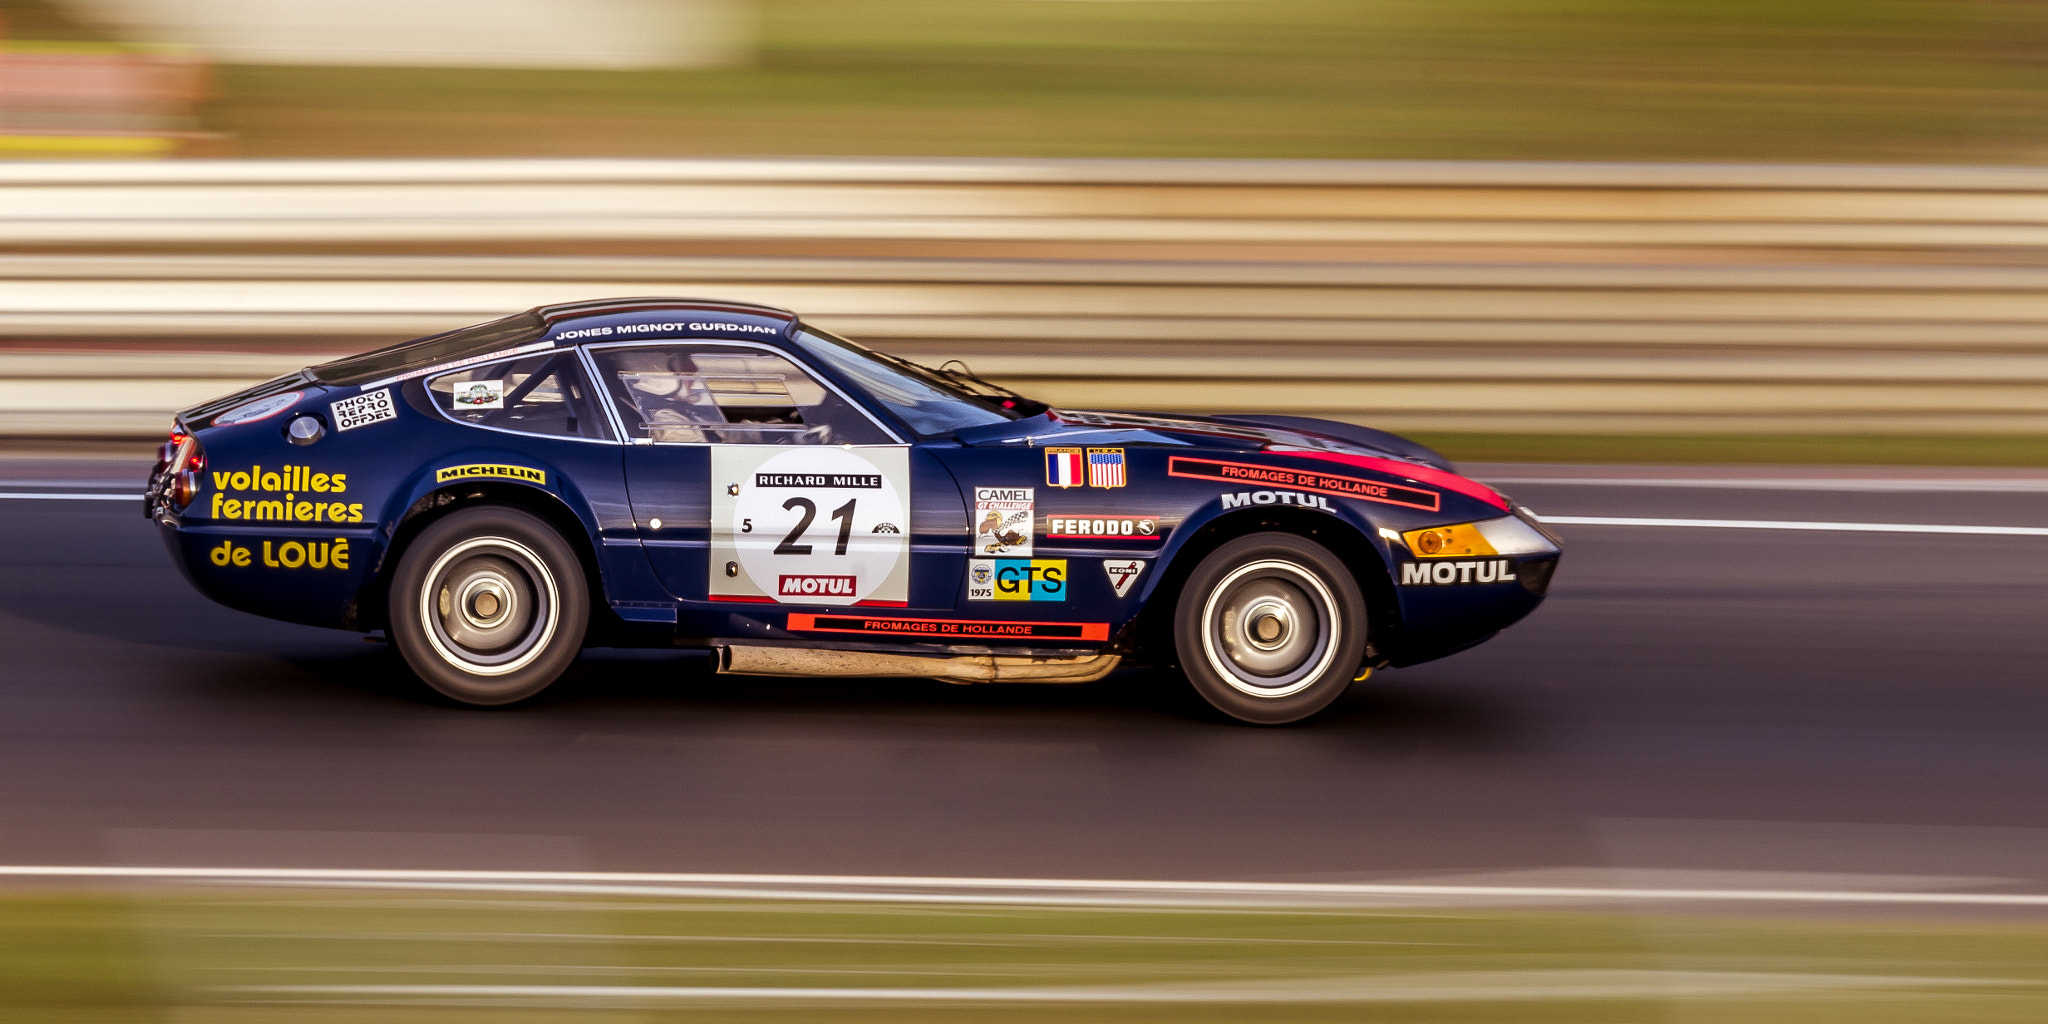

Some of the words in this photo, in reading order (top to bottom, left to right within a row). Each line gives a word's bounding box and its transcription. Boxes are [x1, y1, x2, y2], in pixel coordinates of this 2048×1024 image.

[555, 326, 613, 341] JONES
[616, 322, 686, 334] MIGNOT
[688, 322, 777, 335] GURDJIAN
[335, 391, 386, 411] PHOTO
[337, 399, 388, 418] REPRO
[341, 407, 392, 428] OFFSET
[212, 464, 347, 493] volailles
[441, 466, 541, 481] MICHELIN
[758, 475, 826, 486] RICHARD
[833, 475, 879, 487] MILLE
[1221, 466, 1295, 484] FROMAGES
[1297, 474, 1315, 487] DE
[1319, 477, 1389, 498] HOLLANDE
[977, 489, 1032, 501] CAMEL
[1220, 490, 1337, 514] MOTUL
[211, 492, 364, 523] fermieres
[977, 501, 988, 510] GT
[988, 501, 1032, 510] CHALLENGE
[741, 518, 753, 534] 5
[773, 496, 857, 556] 21
[1052, 519, 1134, 535] FERODO
[210, 540, 252, 567] de
[996, 566, 1062, 594] GTS
[1401, 560, 1517, 585] MOTUL
[781, 577, 853, 594] MOTUL
[970, 588, 992, 597] 1975
[864, 620, 937, 632] FROMAGES
[941, 623, 959, 633] DE
[962, 624, 1032, 635] HOLLANDE
